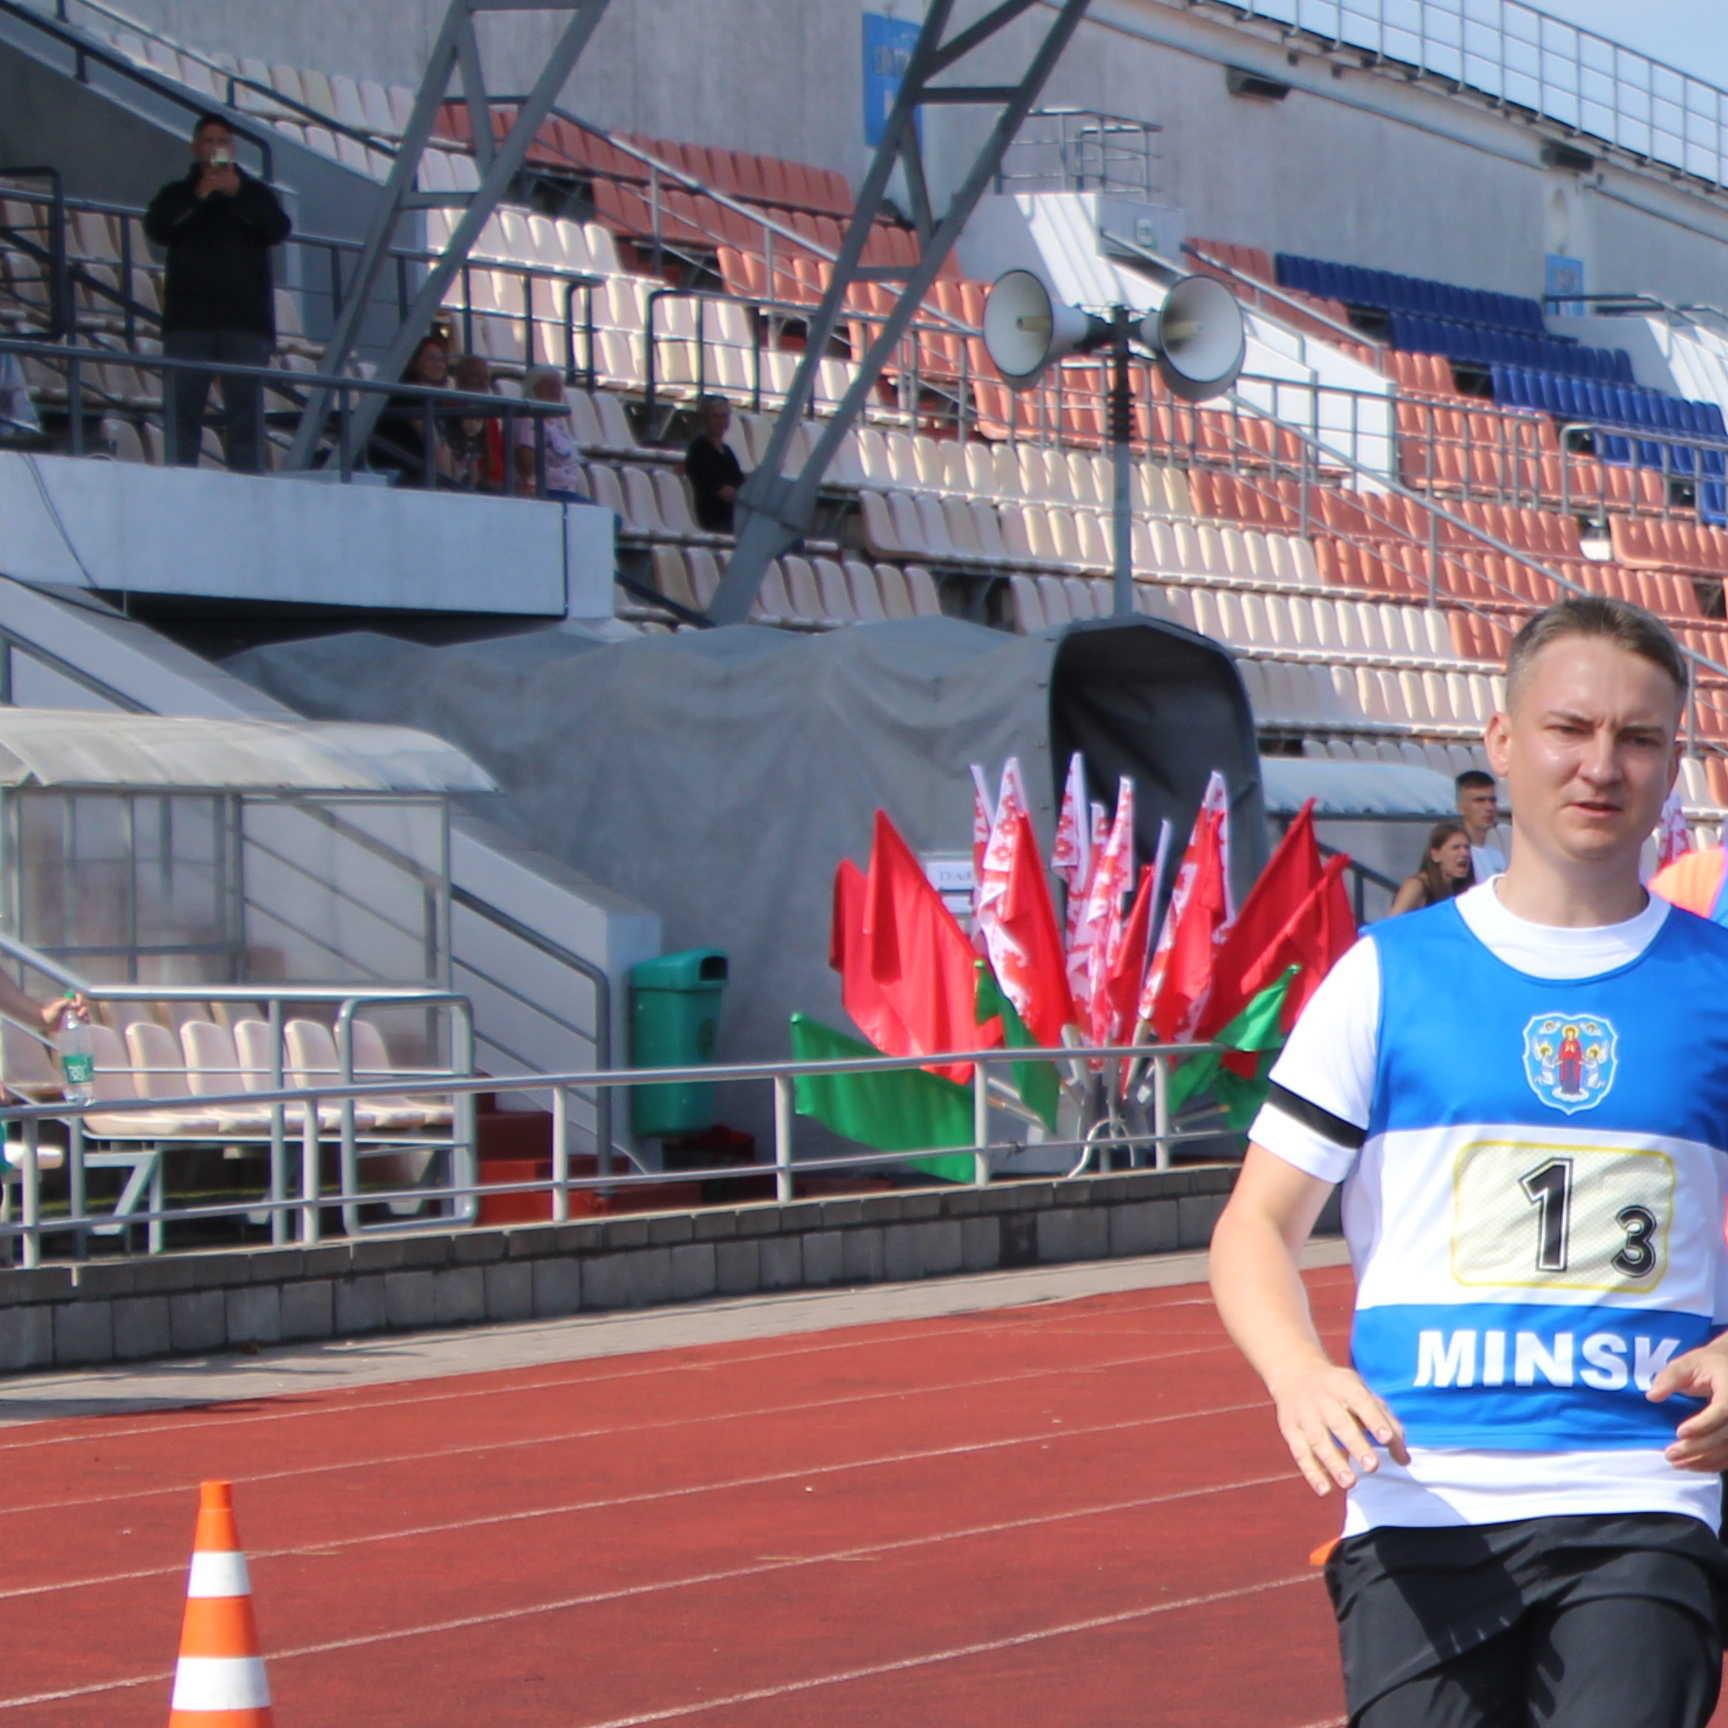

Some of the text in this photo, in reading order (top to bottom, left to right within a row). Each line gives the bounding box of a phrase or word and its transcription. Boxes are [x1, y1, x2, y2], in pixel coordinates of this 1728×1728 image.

[1519, 1156, 1657, 1277] 1 3
[1412, 1329, 1681, 1391] MINSK
